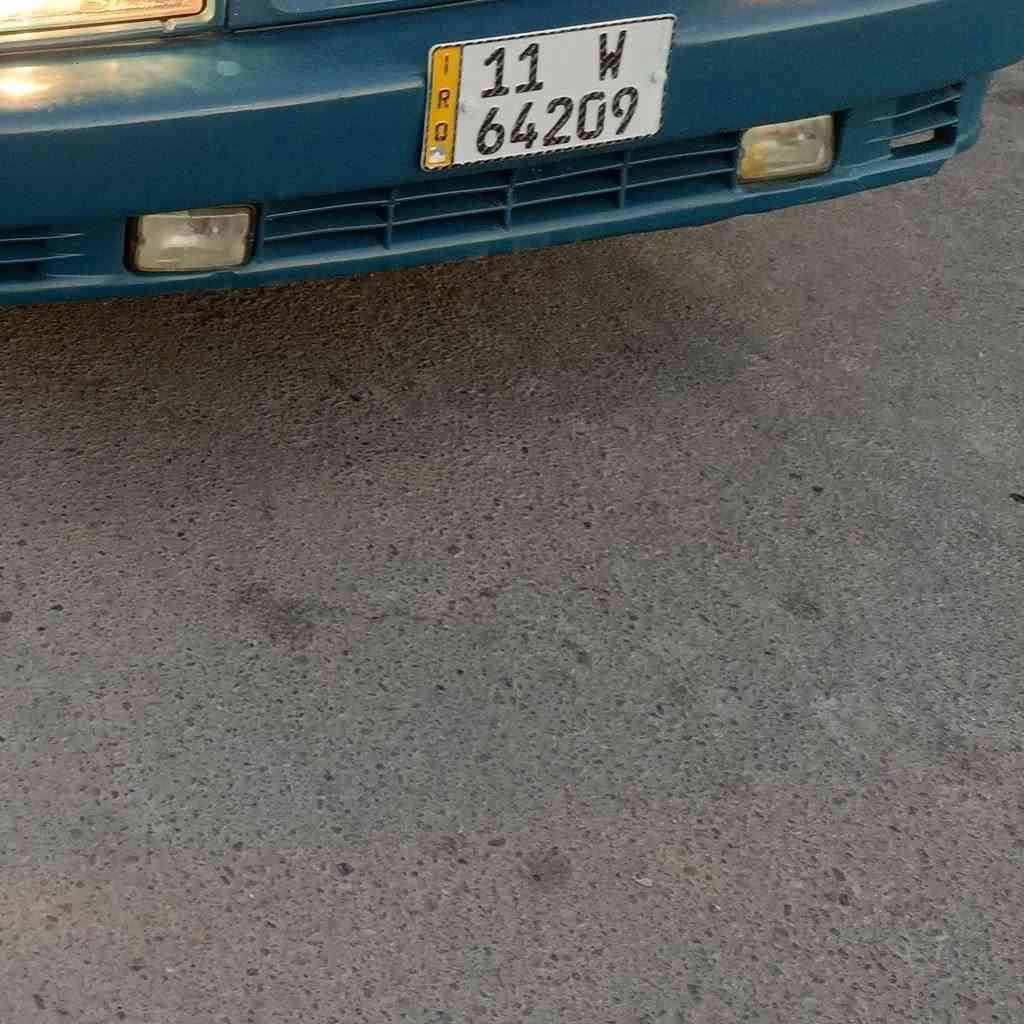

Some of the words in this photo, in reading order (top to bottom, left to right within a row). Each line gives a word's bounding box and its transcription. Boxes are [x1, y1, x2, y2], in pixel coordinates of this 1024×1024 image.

[480, 42, 544, 98] 11
[598, 30, 627, 81] W
[475, 86, 639, 156] 64209
